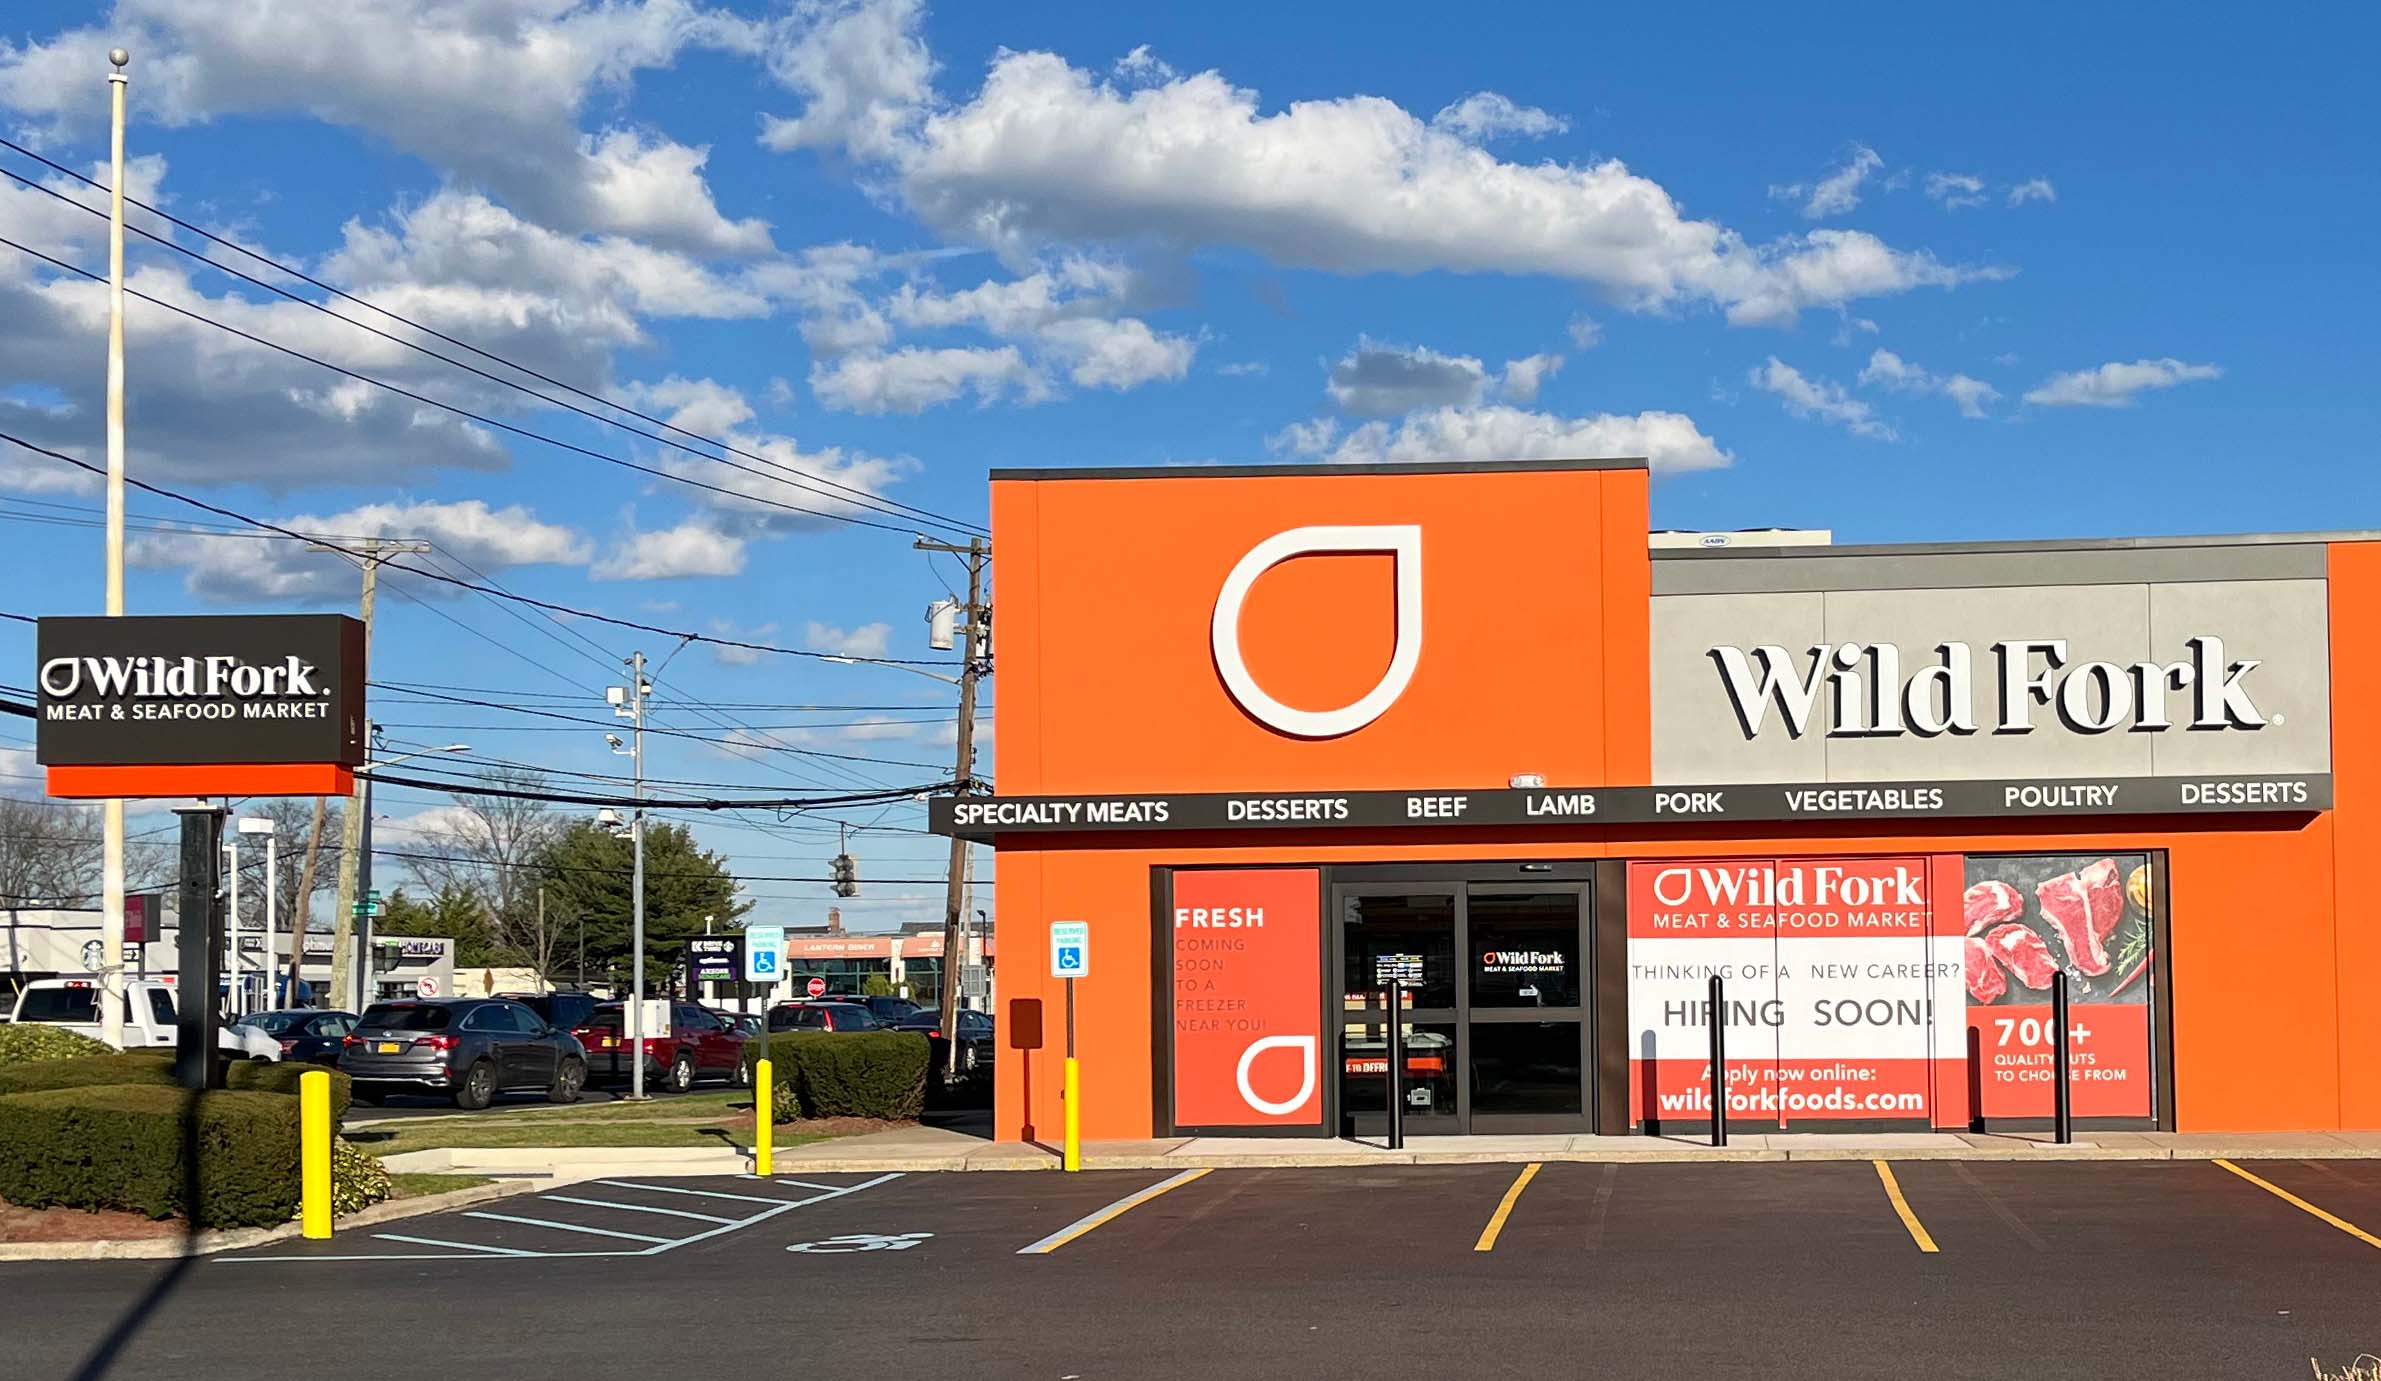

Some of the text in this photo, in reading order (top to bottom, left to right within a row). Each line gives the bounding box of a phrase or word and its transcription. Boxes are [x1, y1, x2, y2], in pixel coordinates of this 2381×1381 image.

[83, 656, 197, 696] Wild
[1706, 640, 1977, 740] Wild
[46, 702, 330, 721] MEAT & SEAFOOD MARKET
[1655, 791, 1725, 814] PORK
[1785, 788, 1944, 812] VEGETABLES
[2005, 784, 2119, 808] POULTRY
[2181, 781, 2308, 805] DESSERTS
[953, 801, 1169, 825] SPECIALTY MEATS
[1227, 798, 1349, 822] DESSERTS
[1407, 796, 1468, 818] BEEF
[1526, 794, 1596, 816] LAMB
[1697, 867, 1804, 906] Wild
[1175, 907, 1264, 928] FRESH
[1653, 911, 1932, 928] MEAT & SEAFOOD MARKET
[1176, 938, 1245, 951] COMING
[1176, 958, 1224, 972] SOON
[1496, 951, 1529, 965] Wild
[1632, 962, 1960, 979] THINKING OF A NEW CAREER?
[1176, 979, 1216, 992] TO A
[1176, 999, 1246, 1012] FREEZER
[1814, 999, 1934, 1026] SOON!
[1176, 1018, 1266, 1032] NEAR YOU!
[1700, 1062, 1876, 1086] Aply now online:
[1995, 1068, 2127, 1082] TO CHOE FROM
